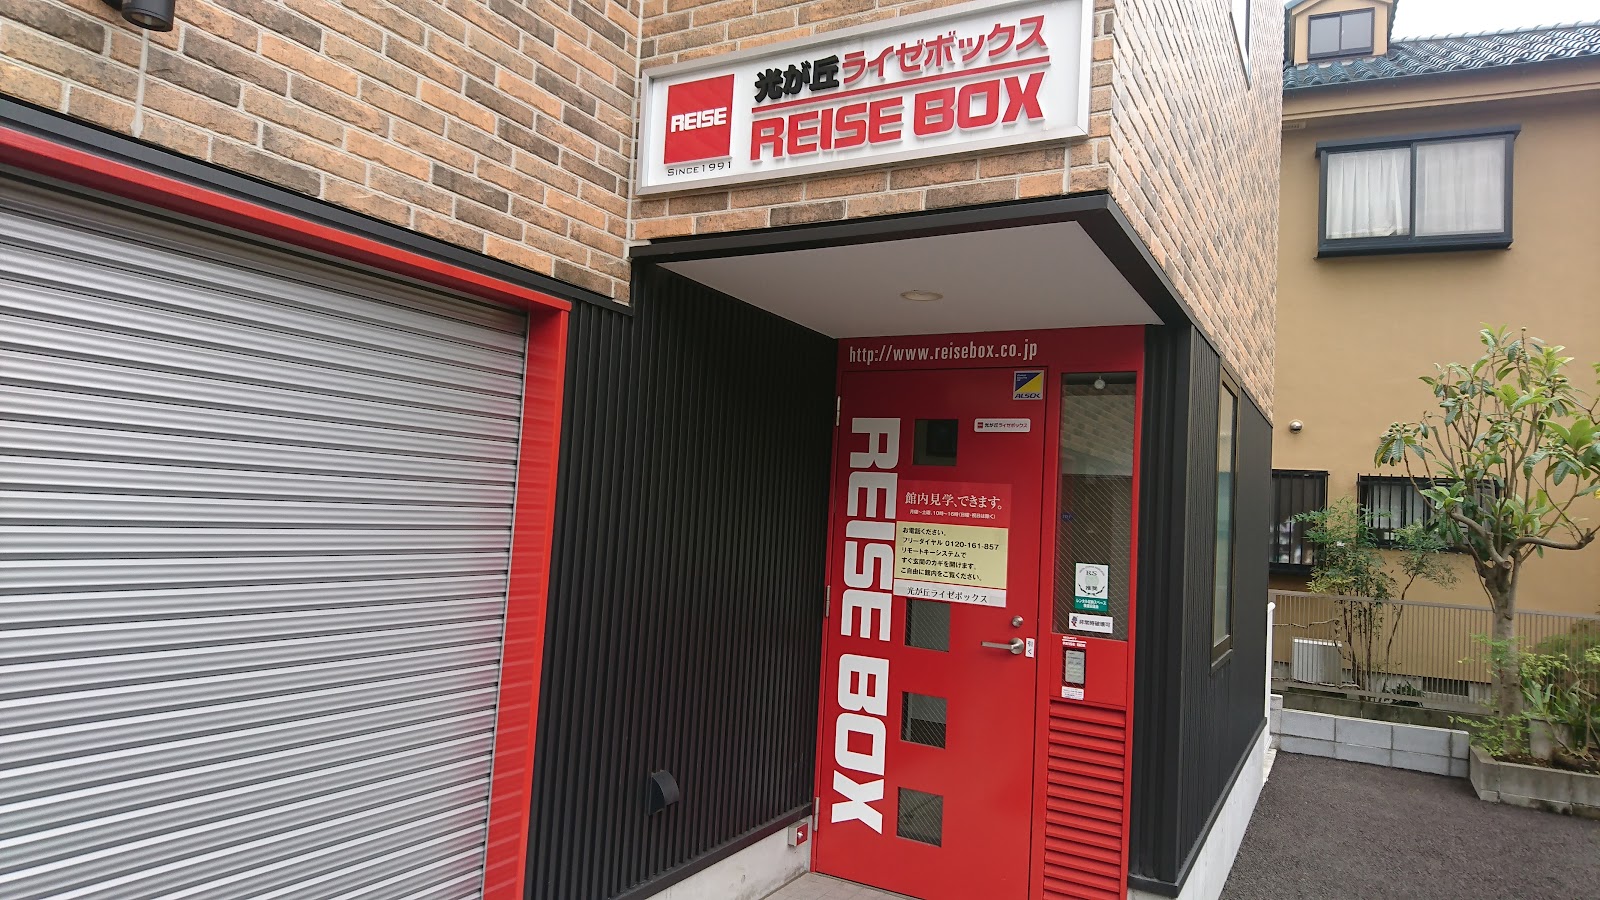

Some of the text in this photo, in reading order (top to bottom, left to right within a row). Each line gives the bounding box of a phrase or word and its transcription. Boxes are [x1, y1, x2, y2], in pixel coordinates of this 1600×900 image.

[754, 15, 1049, 103] 光が丘ライゼボックス
[670, 106, 728, 133] REISE
[750, 71, 1046, 161] REISE BOX
[849, 339, 1038, 366] http://www.reisebox.co.jp
[905, 492, 1003, 510] 館内見学、できます。
[902, 527, 946, 536] お電話ください。
[901, 547, 967, 558] リモートキーシステムで
[902, 537, 1000, 551] フリーダイヤル 0120-161-857
[907, 586, 988, 603] 光が丘ライゼボックス
[831, 417, 900, 835] REISE BOX
